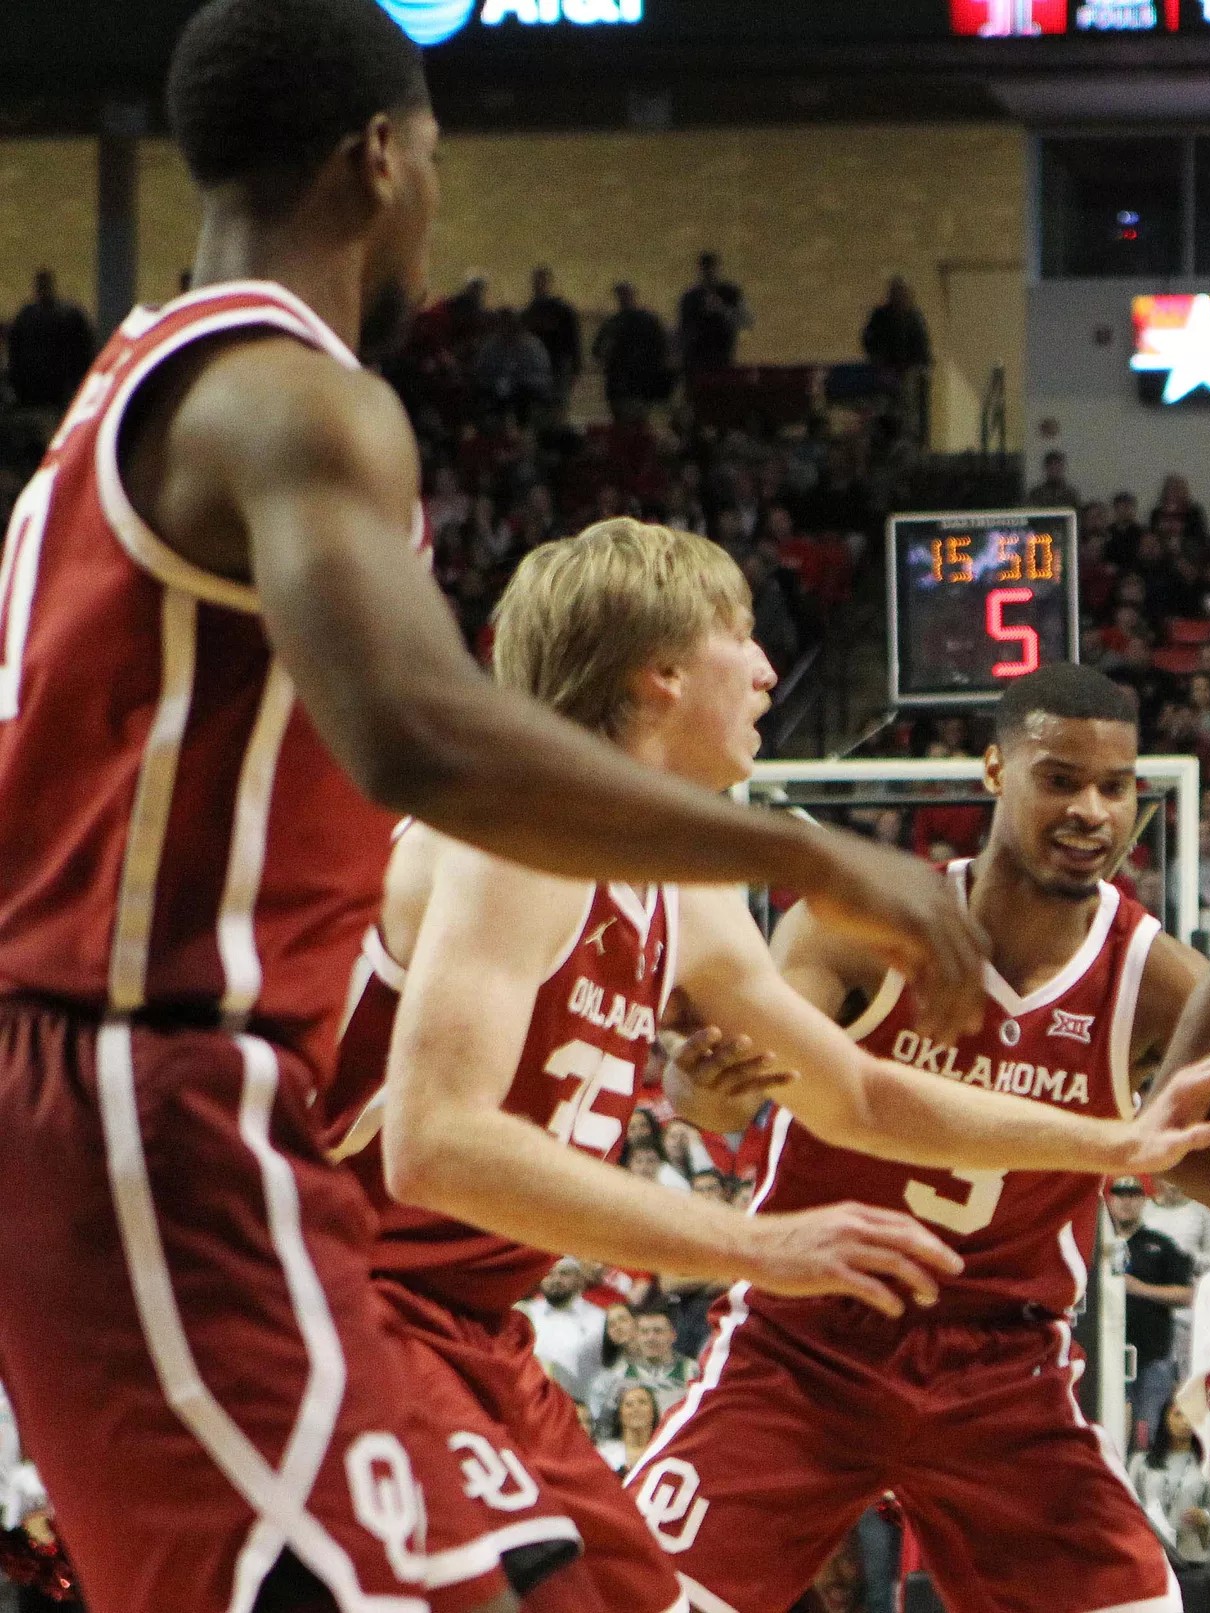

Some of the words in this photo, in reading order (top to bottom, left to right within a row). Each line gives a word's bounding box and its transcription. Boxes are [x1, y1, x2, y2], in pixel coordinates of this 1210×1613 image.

[930, 535, 974, 583] 15
[996, 533, 1054, 580] 50
[985, 587, 1041, 678] 5
[892, 1029, 1091, 1106] OKLAHOMA
[635, 1456, 711, 1554] OU
